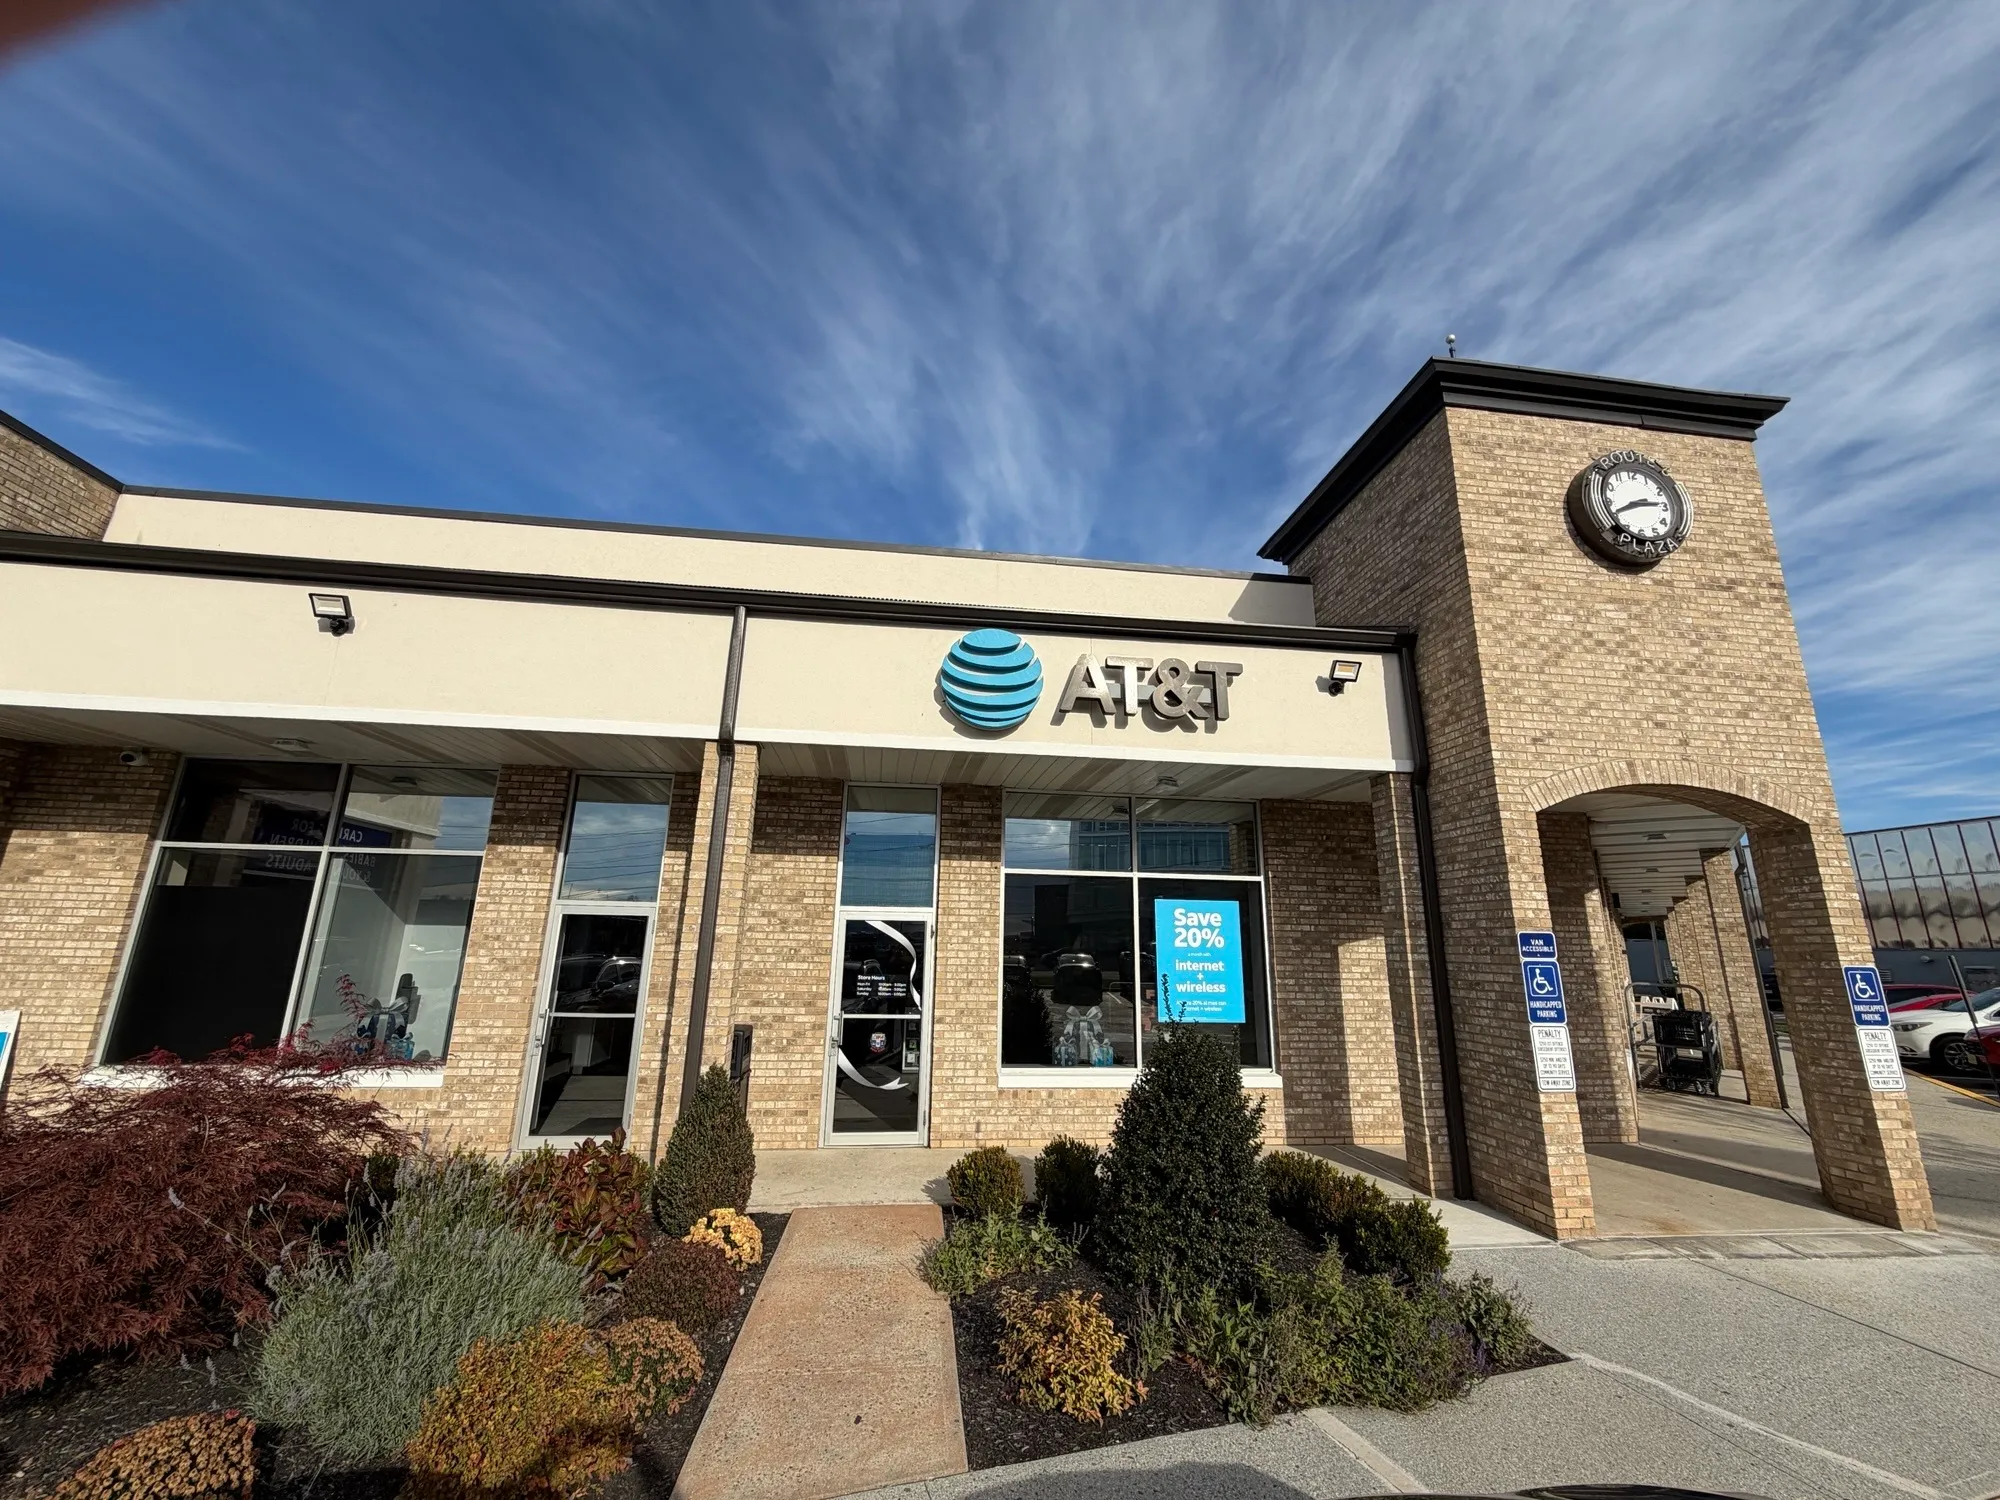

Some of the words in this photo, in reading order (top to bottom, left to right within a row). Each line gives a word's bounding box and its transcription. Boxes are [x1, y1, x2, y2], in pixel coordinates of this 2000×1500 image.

[1599, 450, 1656, 470] ROUTE
[1627, 472, 1638, 481] 12
[1656, 486, 1663, 497] 2
[1660, 501, 1669, 512] 3
[1659, 517, 1668, 527] 4
[1619, 532, 1679, 554] PLAZA
[1058, 653, 1244, 722] AT&T
[1173, 907, 1222, 927] Save
[1174, 927, 1225, 948] 20%
[1522, 945, 1554, 953] ACCESSIBLE
[1175, 959, 1225, 971] internet
[1196, 972, 1204, 980] +
[1175, 981, 1226, 993] wireless
[1529, 1000, 1562, 1009] HANDICAPPED
[1853, 1004, 1885, 1012] HANDICAPPED
[1536, 1010, 1558, 1018] PARKING
[1861, 1013, 1882, 1021] PARKING
[1537, 1029, 1561, 1038] PENALTY
[1864, 1031, 1887, 1040] PENALTY
